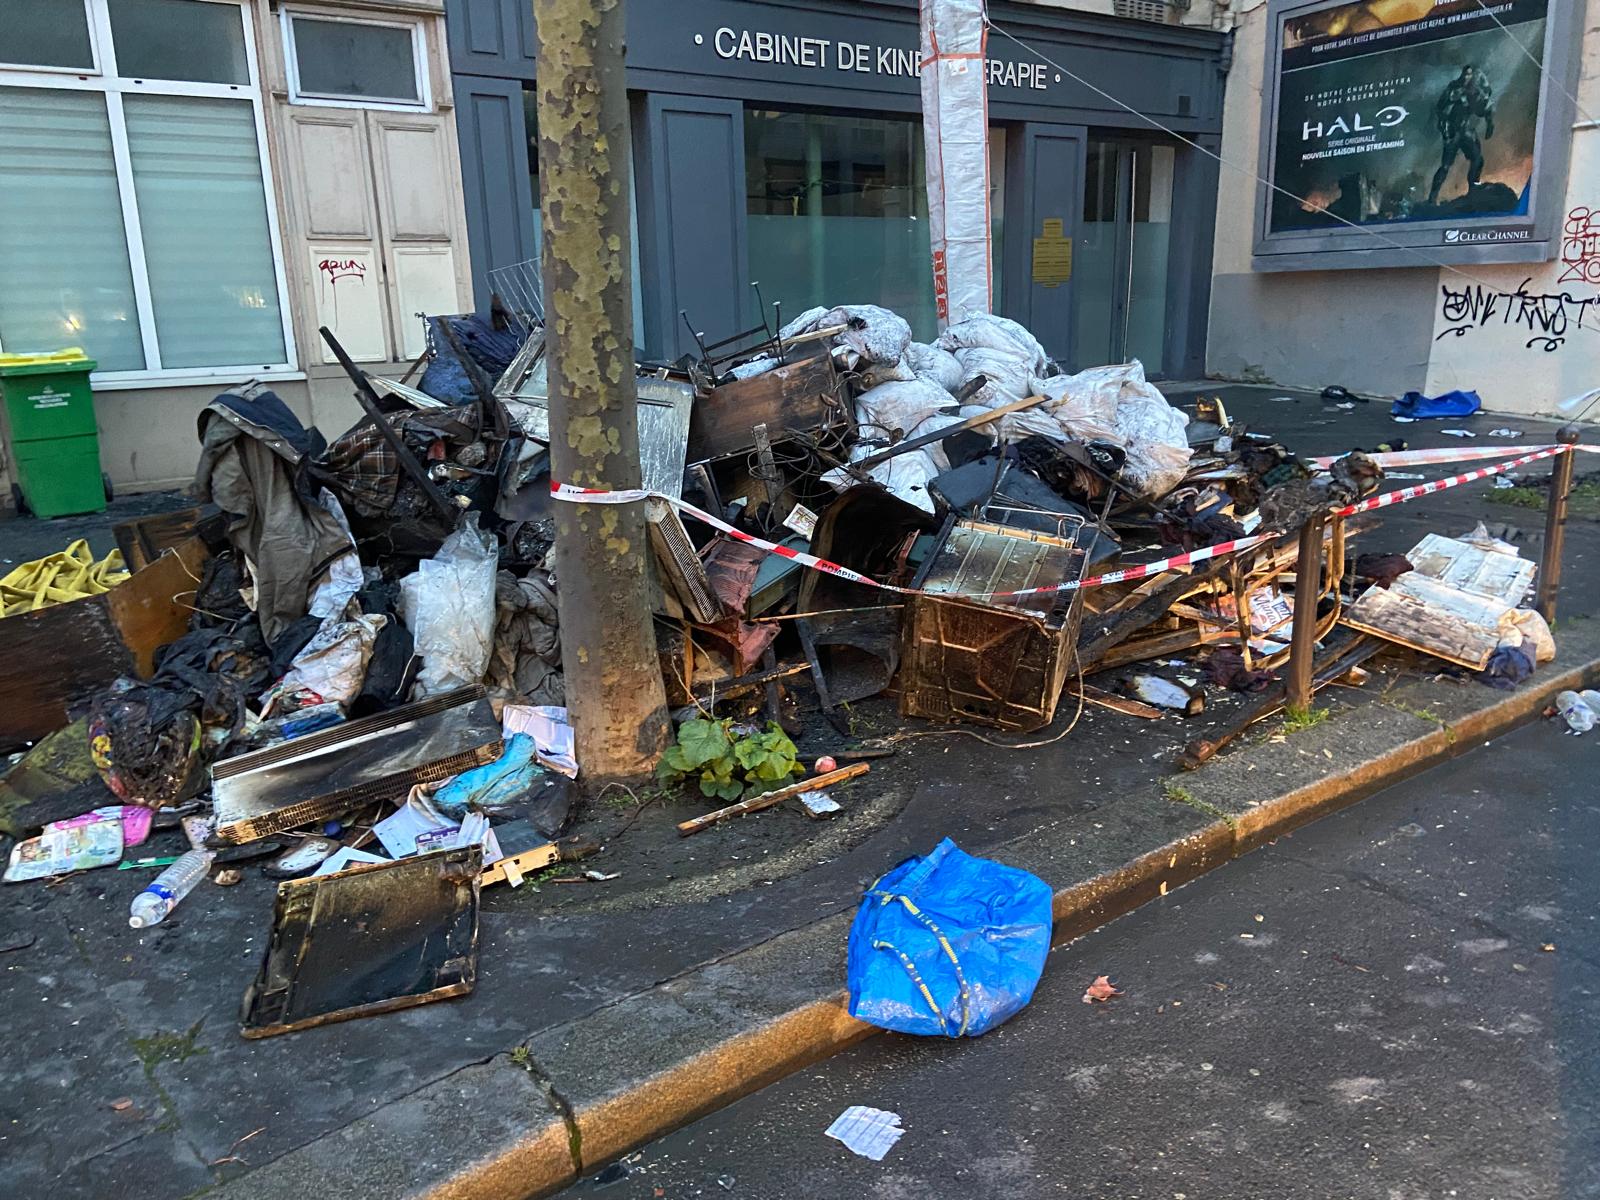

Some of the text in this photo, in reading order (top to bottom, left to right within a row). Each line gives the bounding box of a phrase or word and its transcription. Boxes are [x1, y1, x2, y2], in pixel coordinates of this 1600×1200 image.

[1418, 22, 1428, 32] LES
[714, 27, 830, 68] CABINET
[837, 42, 871, 72] DE
[1317, 88, 1343, 99] NOTRE
[1347, 83, 1374, 94] CHUTE
[1317, 88, 1395, 107] NOTRE ASCENSION
[1302, 105, 1410, 140] HALO
[1301, 139, 1405, 160] NOUVELLE SAISON EN STREAMING
[1344, 134, 1377, 146] ORIGINALE
